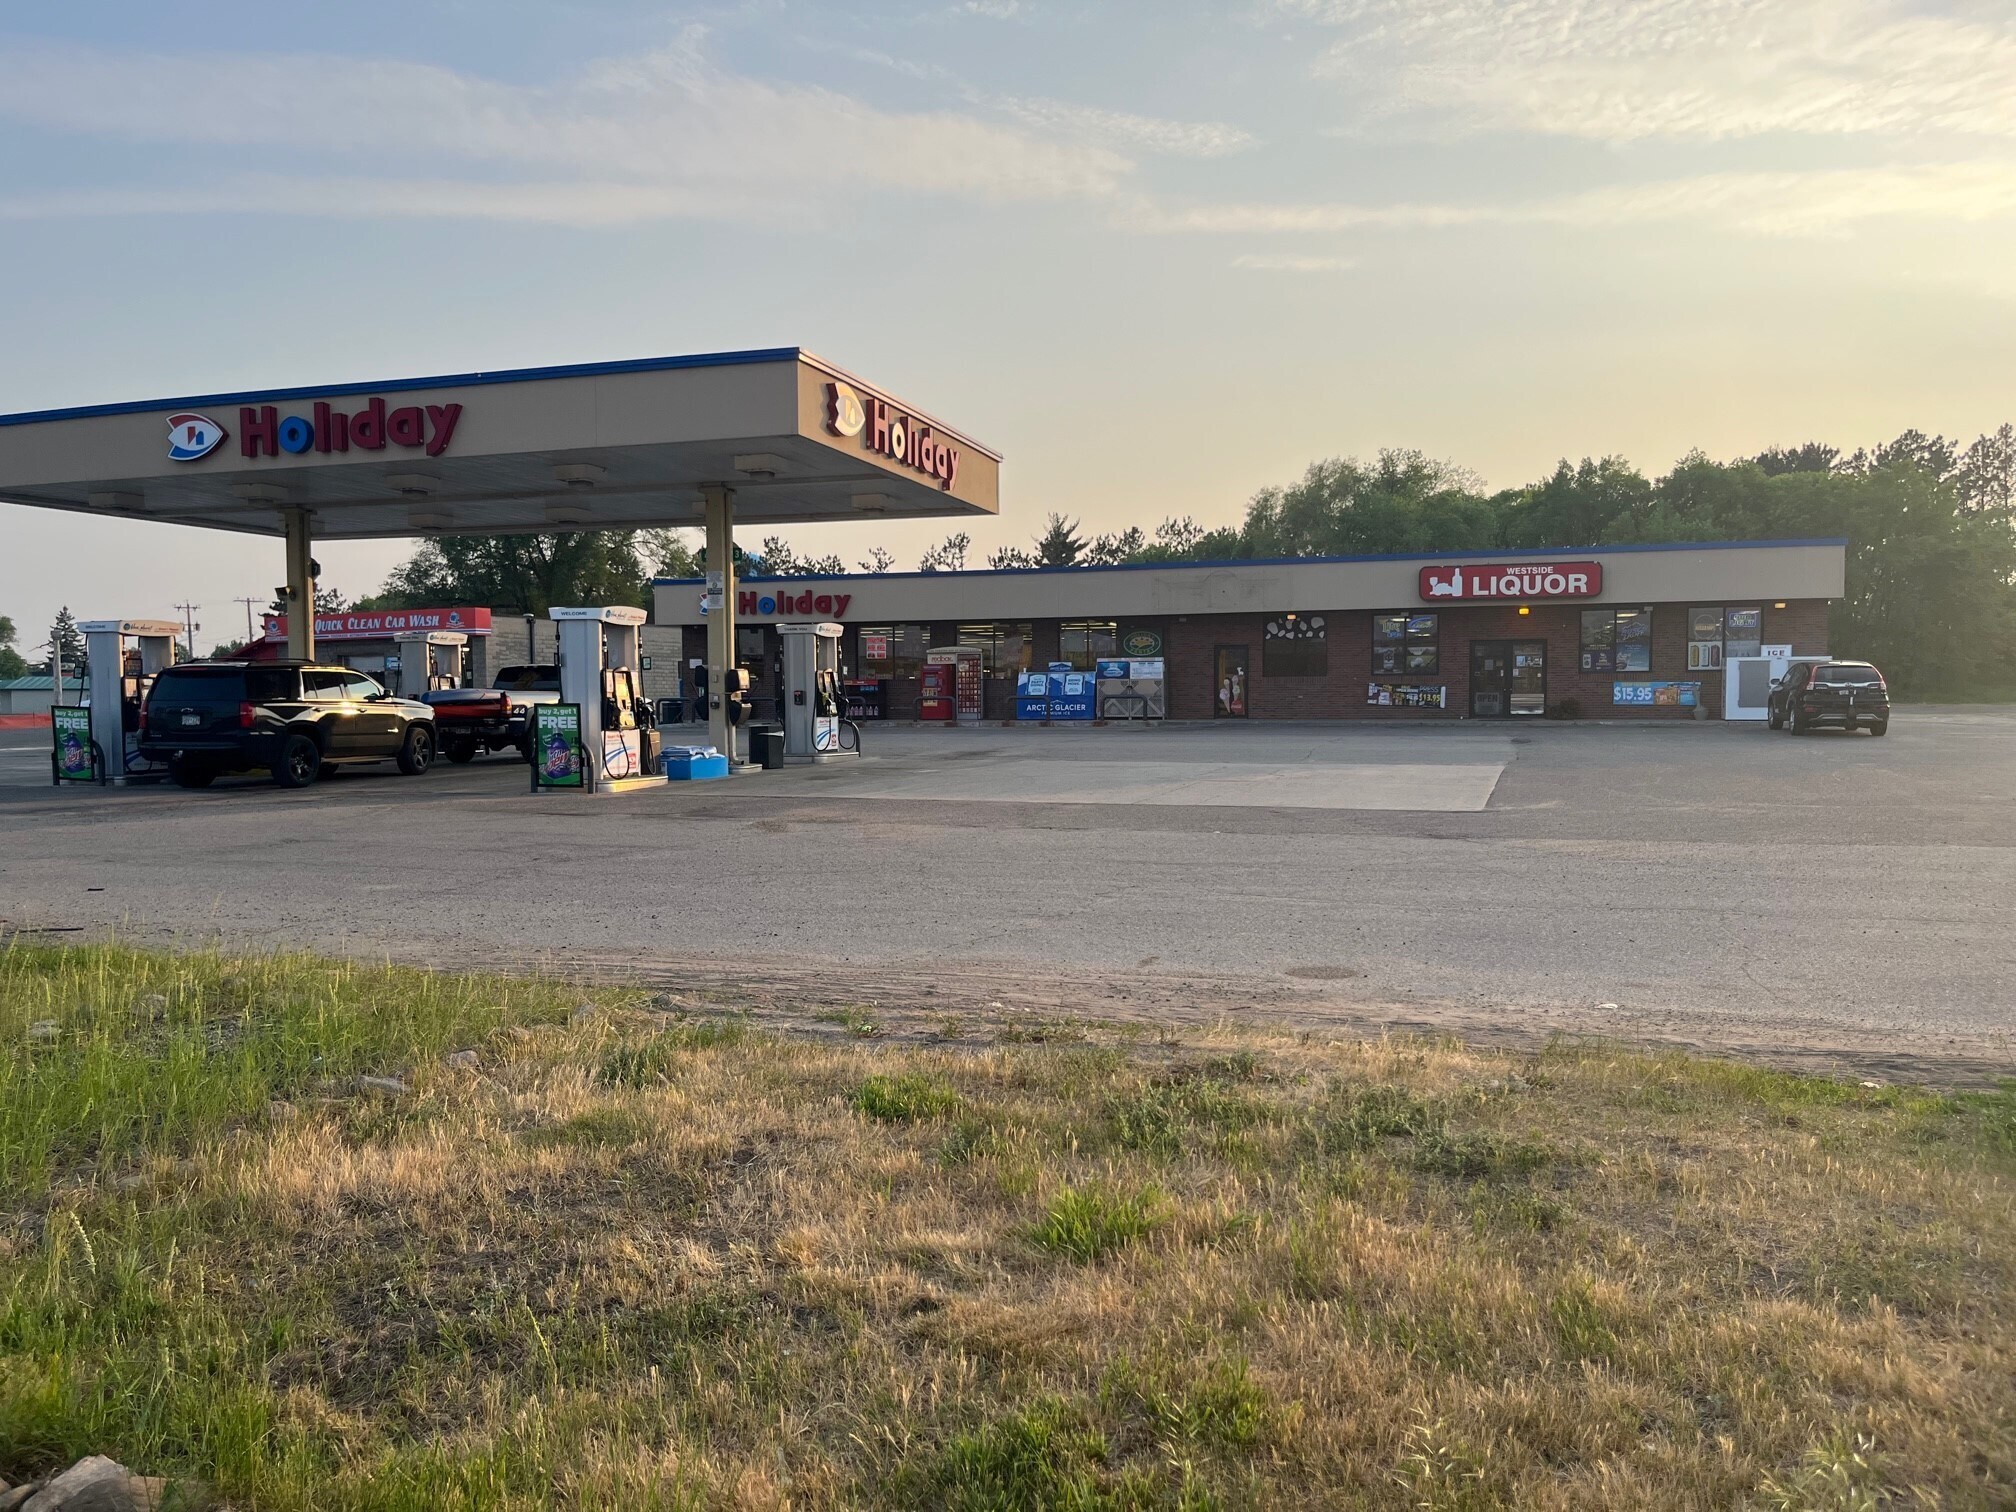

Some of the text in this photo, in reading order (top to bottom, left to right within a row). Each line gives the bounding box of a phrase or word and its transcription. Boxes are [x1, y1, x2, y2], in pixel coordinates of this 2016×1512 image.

[239, 398, 463, 458] Holiday
[866, 398, 961, 491] Holiday
[734, 550, 740, 559] 3
[1506, 566, 1554, 575] WESTSIDE
[1472, 574, 1588, 596] LIQUOR
[738, 590, 852, 618] Holiday
[315, 614, 439, 633] QUICK CLEAN CAR WASH
[1767, 649, 1785, 657] ICE
[1613, 686, 1652, 701] $15.95
[538, 708, 552, 717] buy
[559, 708, 572, 716] get
[1055, 703, 1086, 711] GLACIER
[56, 718, 89, 729] FREE
[538, 717, 578, 729] FREE
